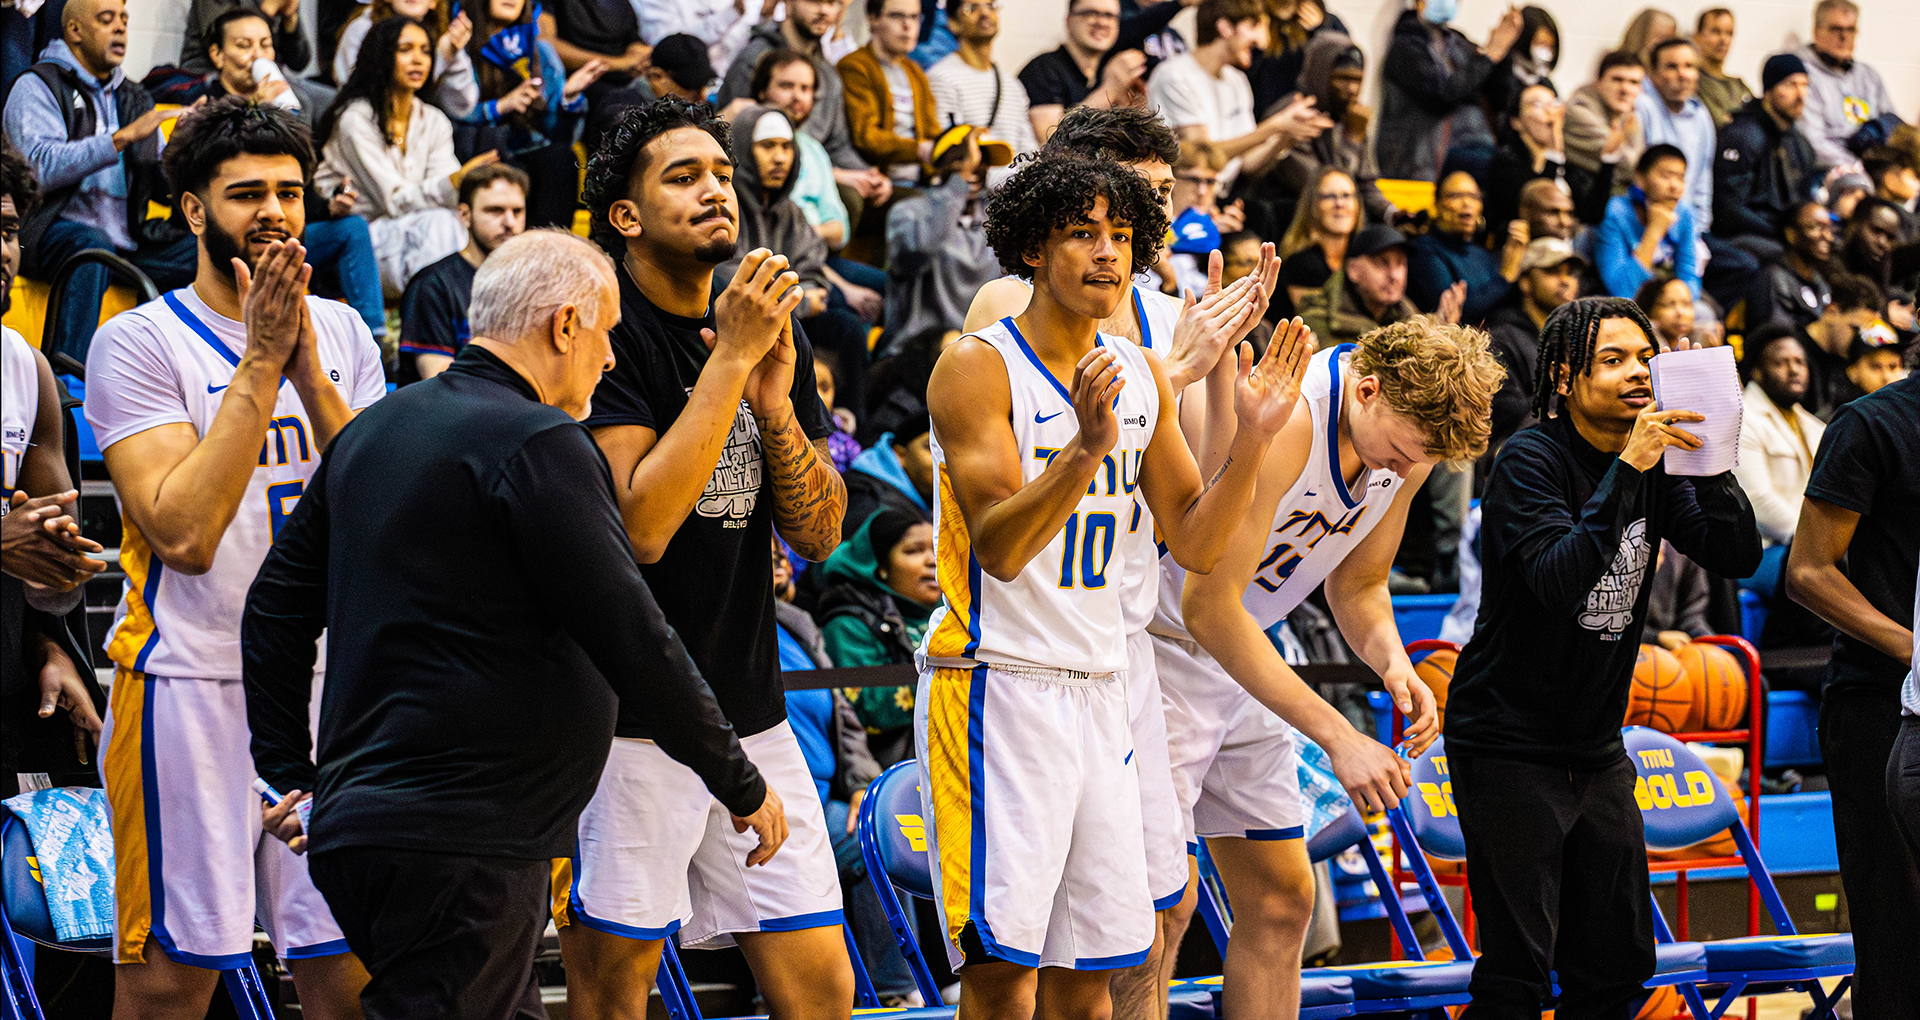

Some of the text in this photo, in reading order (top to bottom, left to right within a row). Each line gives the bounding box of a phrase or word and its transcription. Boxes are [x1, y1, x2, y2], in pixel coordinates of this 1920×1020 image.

[1123, 418, 1139, 426] BMO
[1058, 510, 1118, 591] 10
[1065, 668, 1090, 680] TMU
[1637, 748, 1675, 769] TMU
